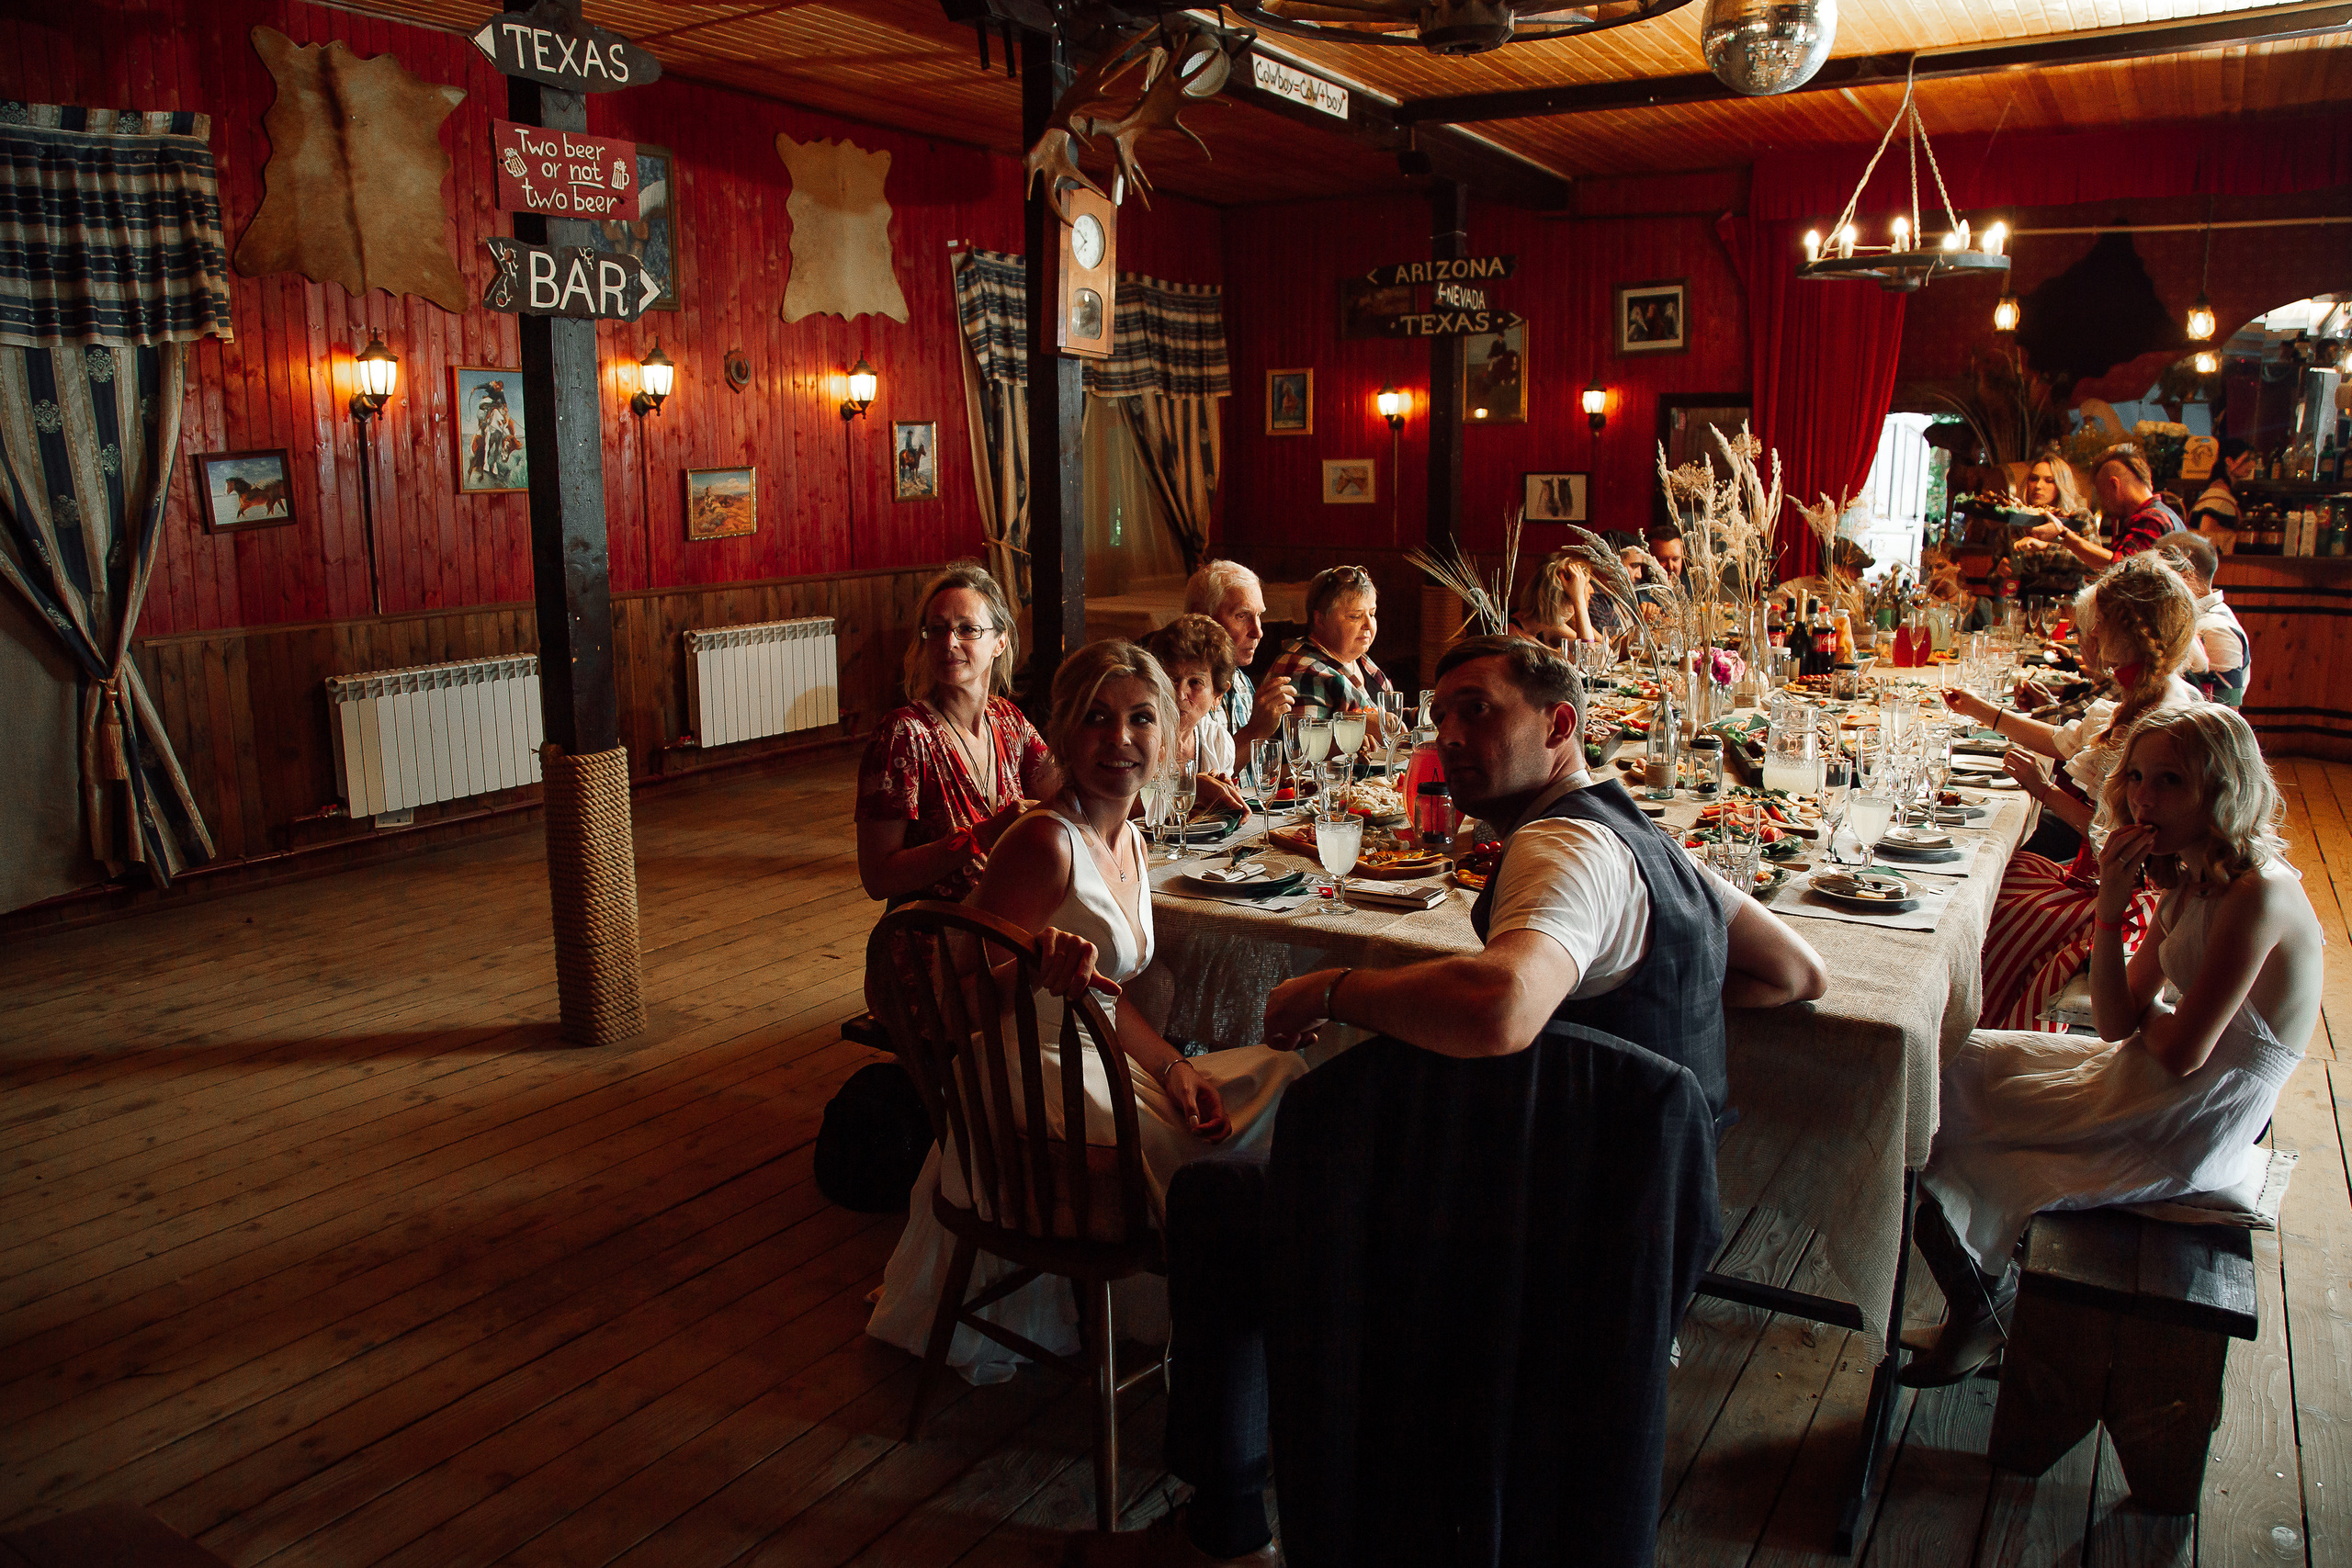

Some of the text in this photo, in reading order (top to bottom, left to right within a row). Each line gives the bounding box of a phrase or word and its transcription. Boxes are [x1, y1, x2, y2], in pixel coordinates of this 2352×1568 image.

[503, 23, 629, 83] TEXAS
[514, 129, 605, 161] Two beer
[541, 161, 604, 182] or not
[522, 177, 617, 214] two beer
[530, 251, 629, 317] BAR
[1395, 256, 1506, 284] ARIZONA
[1446, 285, 1487, 310] NEVADA
[1399, 311, 1490, 335] TEXAS
